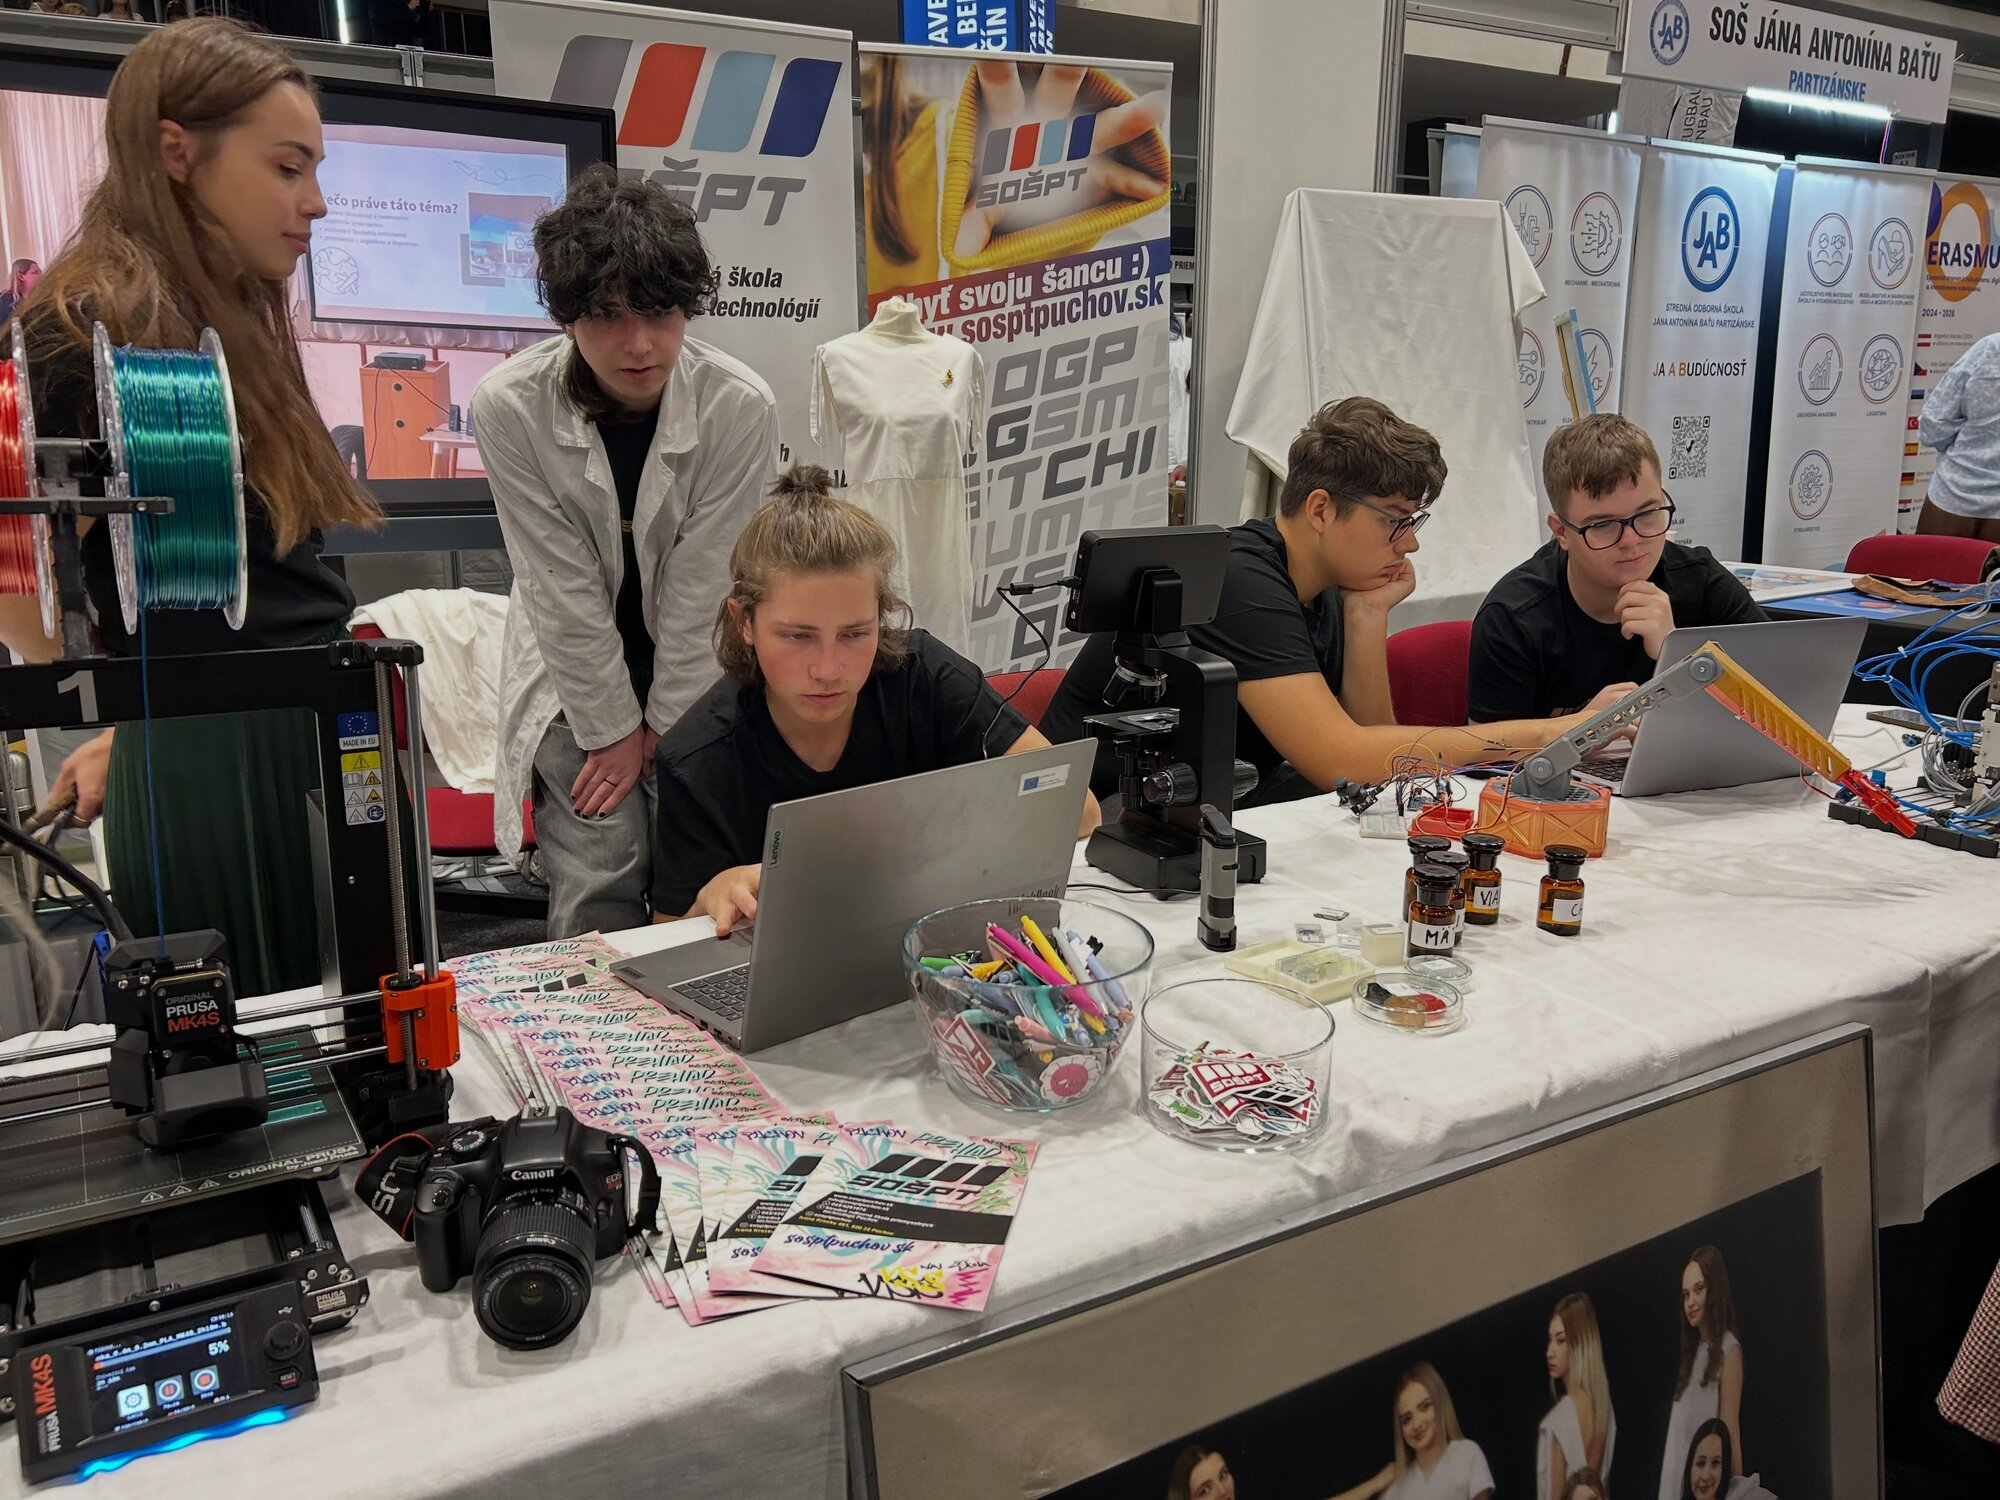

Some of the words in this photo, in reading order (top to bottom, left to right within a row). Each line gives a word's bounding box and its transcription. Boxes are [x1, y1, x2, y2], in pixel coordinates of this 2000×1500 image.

[1657, 12, 1684, 51] JAB
[1709, 2, 1749, 46] SOŠ
[1754, 9, 1801, 55] JÁNA
[1807, 27, 1892, 74] ANTONÍNA
[1898, 41, 1942, 82] BAŤU
[1789, 69, 1867, 102] PARTIZÁNSKE
[976, 167, 1088, 209] SOŠPT
[352, 196, 388, 210] práve
[391, 198, 417, 211] táto
[420, 200, 458, 214] téma?
[1692, 211, 1731, 269] JAB
[728, 266, 783, 288] škola
[959, 271, 1033, 312] svoju
[1042, 257, 1123, 294] šancu
[709, 297, 821, 323] technológií
[929, 279, 1165, 344] sosptpuchov.sk
[1665, 302, 1692, 313] STREDNÁ
[1693, 302, 1723, 314] ODBORNÁ
[1723, 302, 1744, 314] ŠKOLA
[1652, 317, 1668, 326] JÁNA
[1669, 317, 1698, 328] ANTONÍNA
[1699, 318, 1715, 328] BAŤU
[1715, 318, 1755, 329] PARTIZÁNSKE
[1652, 361, 1666, 377] JA
[1668, 362, 1676, 376] A
[1678, 358, 1747, 377] BUDÚCNOSŤ
[56, 669, 99, 723] 1
[342, 739, 359, 748] MADE
[360, 738, 367, 746] IN
[367, 737, 376, 745] EU
[769, 830, 781, 865] Lenovo
[165, 991, 214, 1006] ORIGINAL
[166, 1000, 219, 1018] PRUSA
[167, 1011, 220, 1033] MK4S
[1209, 1072, 1265, 1093] SOŠPT
[227, 1156, 302, 1180] ORIGINAL
[301, 1145, 358, 1165] PRUSA
[286, 1164, 300, 1172] by
[511, 1168, 555, 1181] Canon
[605, 1170, 622, 1184] EOS
[847, 1173, 984, 1201] SOŠPT
[526, 1236, 556, 1245] Canon
[316, 1289, 345, 1302] PRUSA
[208, 1339, 230, 1357] 5%
[31, 1353, 57, 1417] MK4S
[46, 1410, 62, 1453] PRUSA
